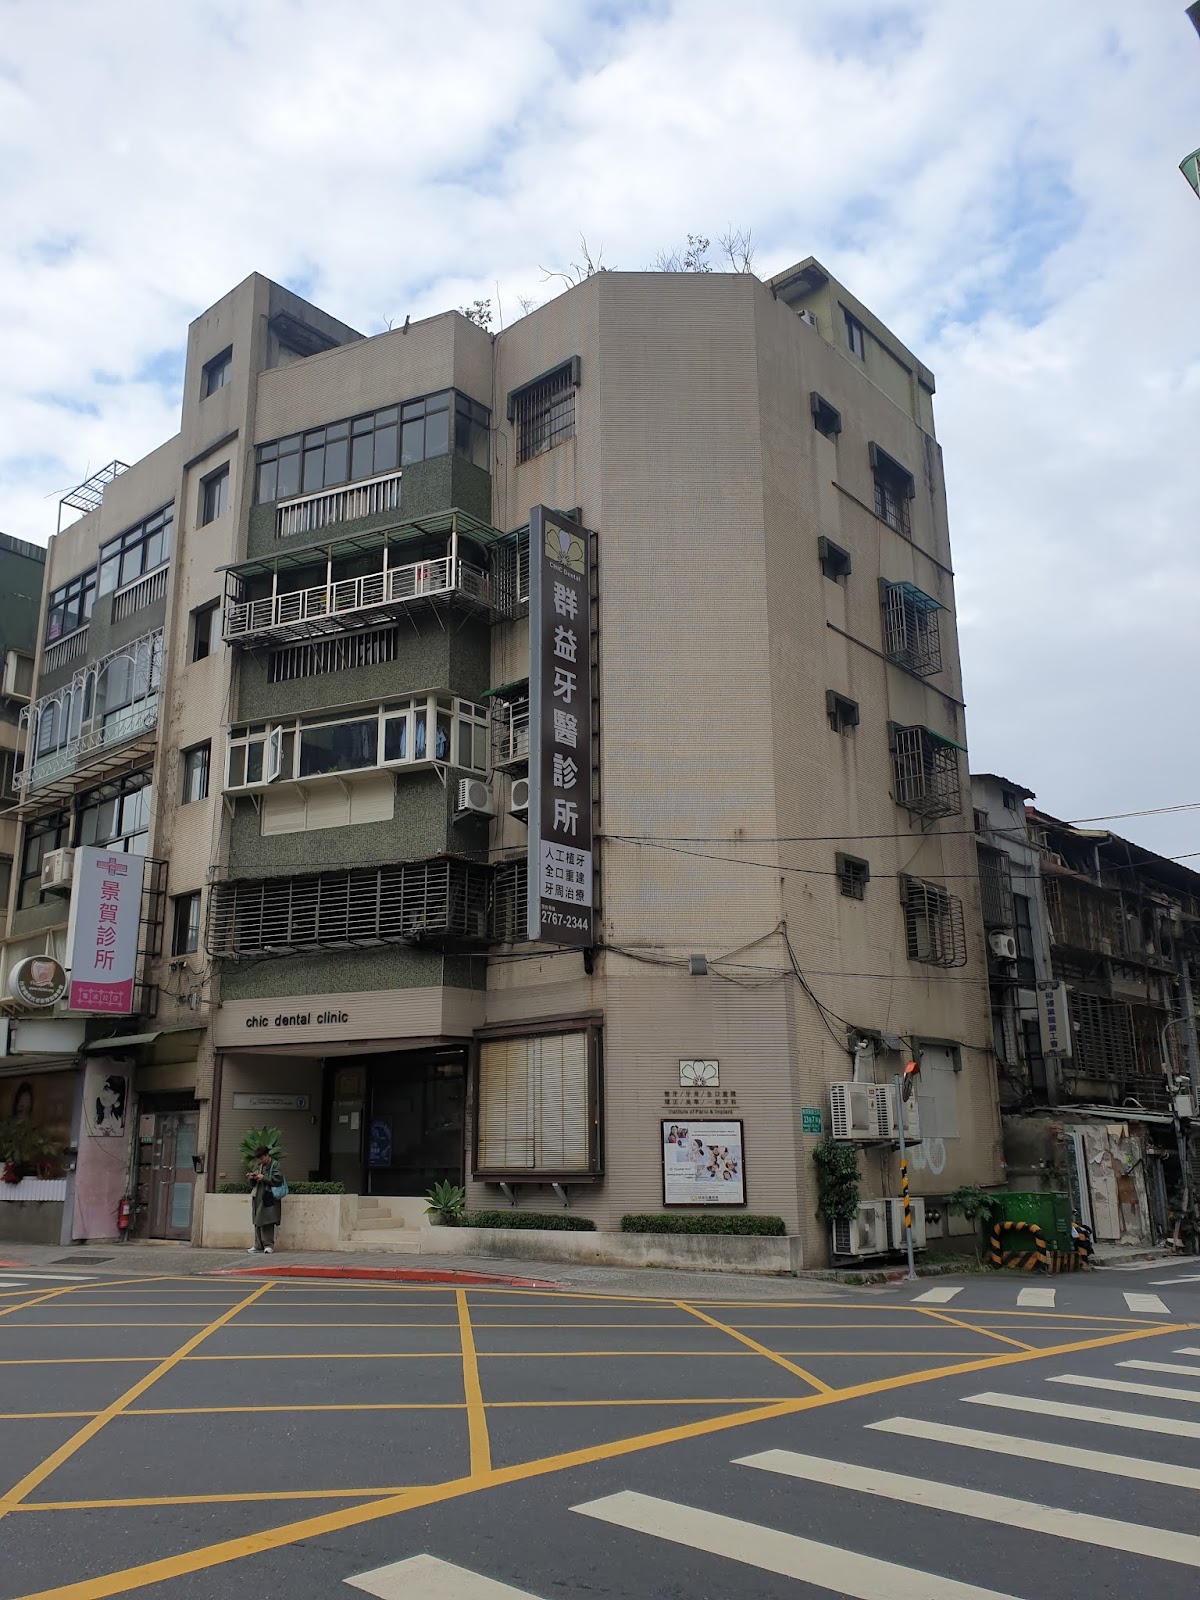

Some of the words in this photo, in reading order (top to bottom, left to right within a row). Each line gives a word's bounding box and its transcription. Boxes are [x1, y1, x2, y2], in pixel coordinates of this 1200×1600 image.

[549, 561, 563, 573] CHIC
[563, 568, 581, 582] Dental
[552, 580, 579, 837] 群益牙醫診所
[545, 846, 585, 867] 人工植牙
[545, 864, 585, 885] 全口重建
[544, 881, 585, 902] 牙周治療
[94, 880, 121, 971] 景賀診所
[541, 910, 589, 931] 2767-2344
[246, 1015, 269, 1028] chic
[274, 1013, 311, 1027] dental
[317, 1010, 349, 1024] clinic
